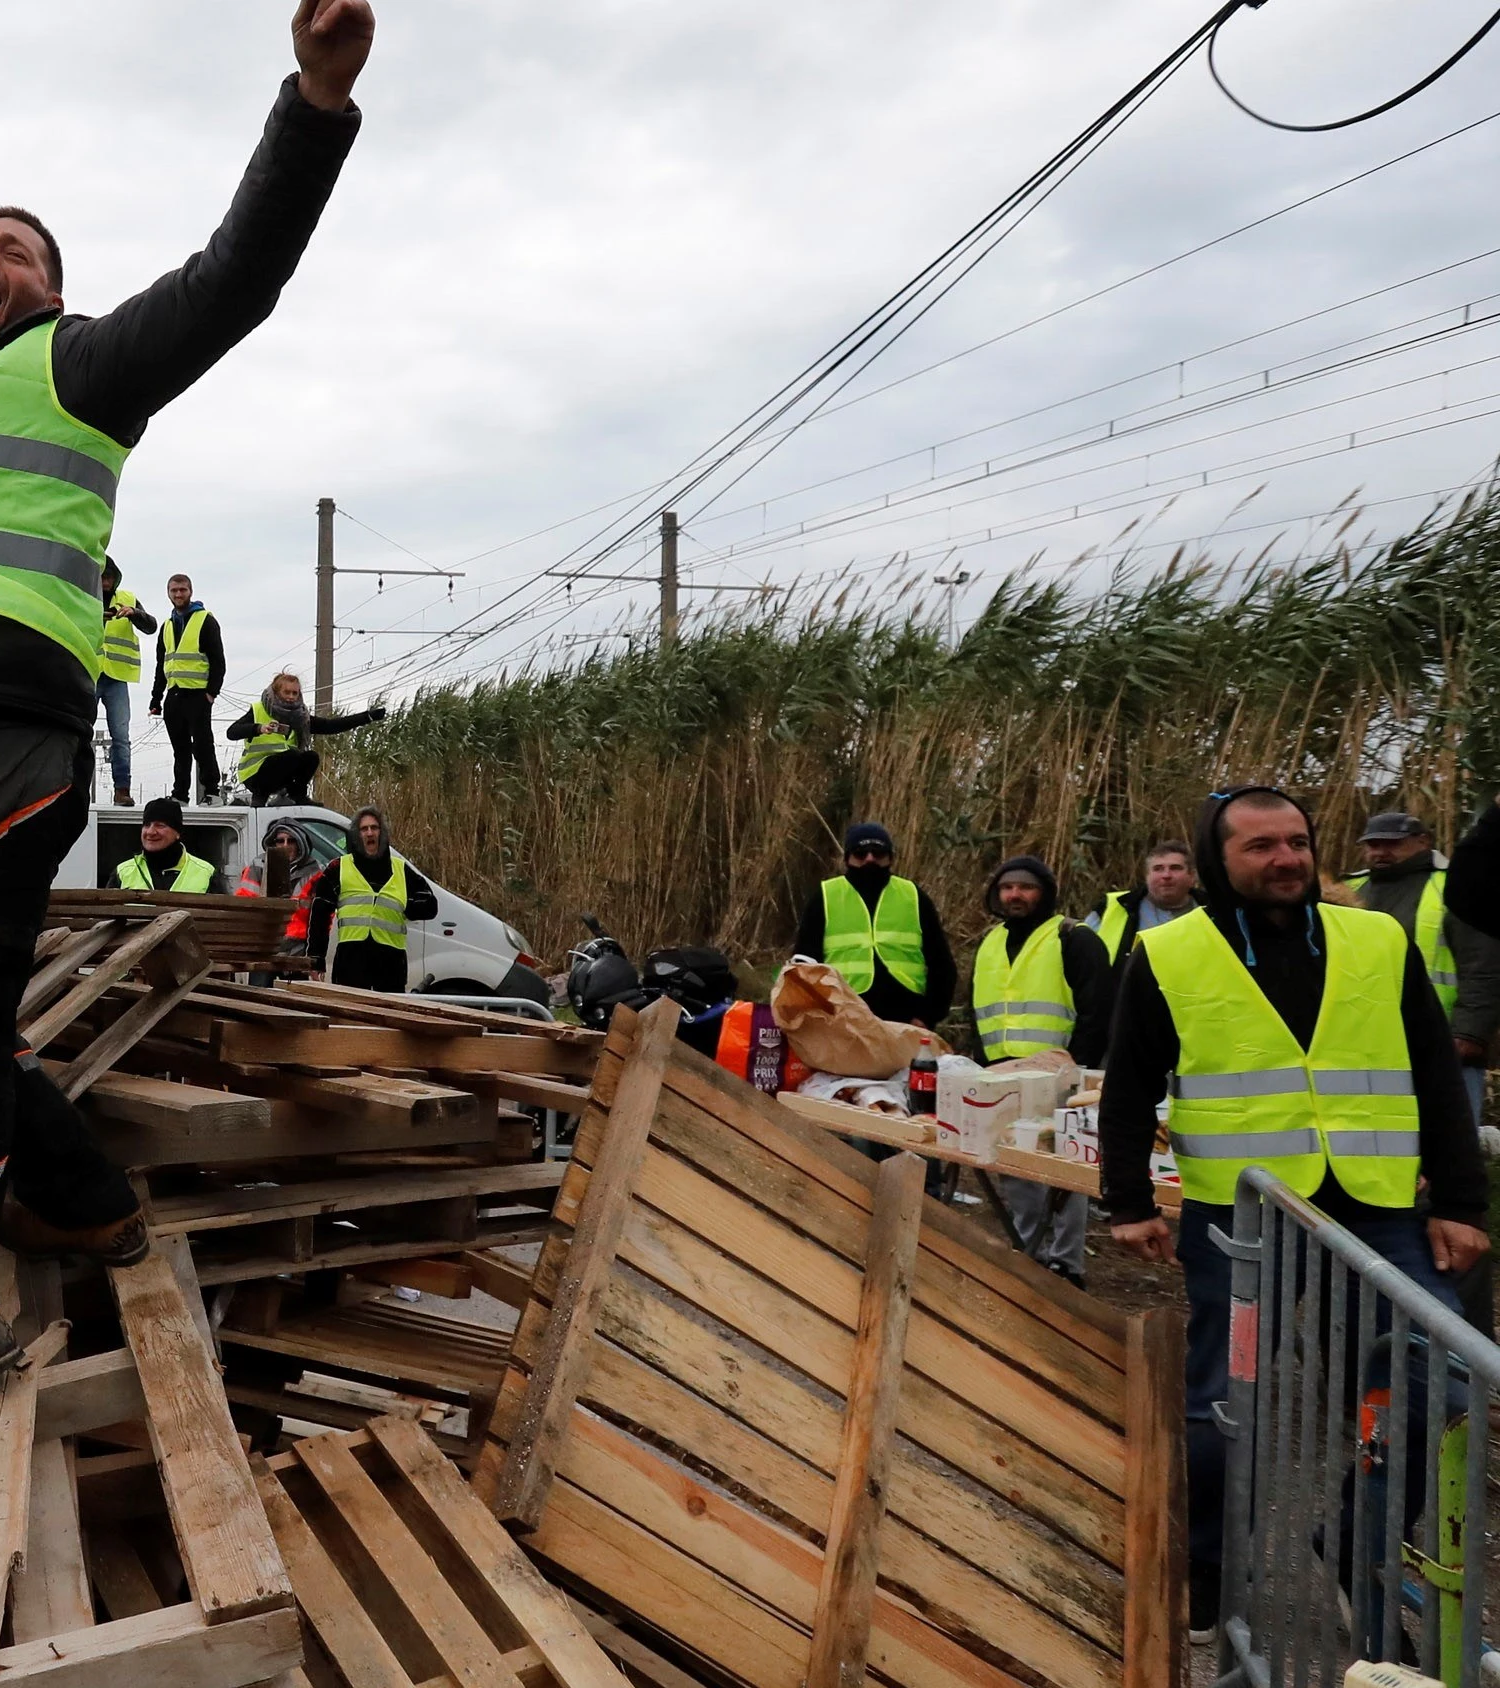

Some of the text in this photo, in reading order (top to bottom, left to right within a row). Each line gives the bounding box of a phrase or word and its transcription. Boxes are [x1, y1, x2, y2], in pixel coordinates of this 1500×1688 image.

[759, 1028, 781, 1038] PRIX
[756, 1056, 780, 1066] 1000
[754, 1067, 777, 1078] PRIX
